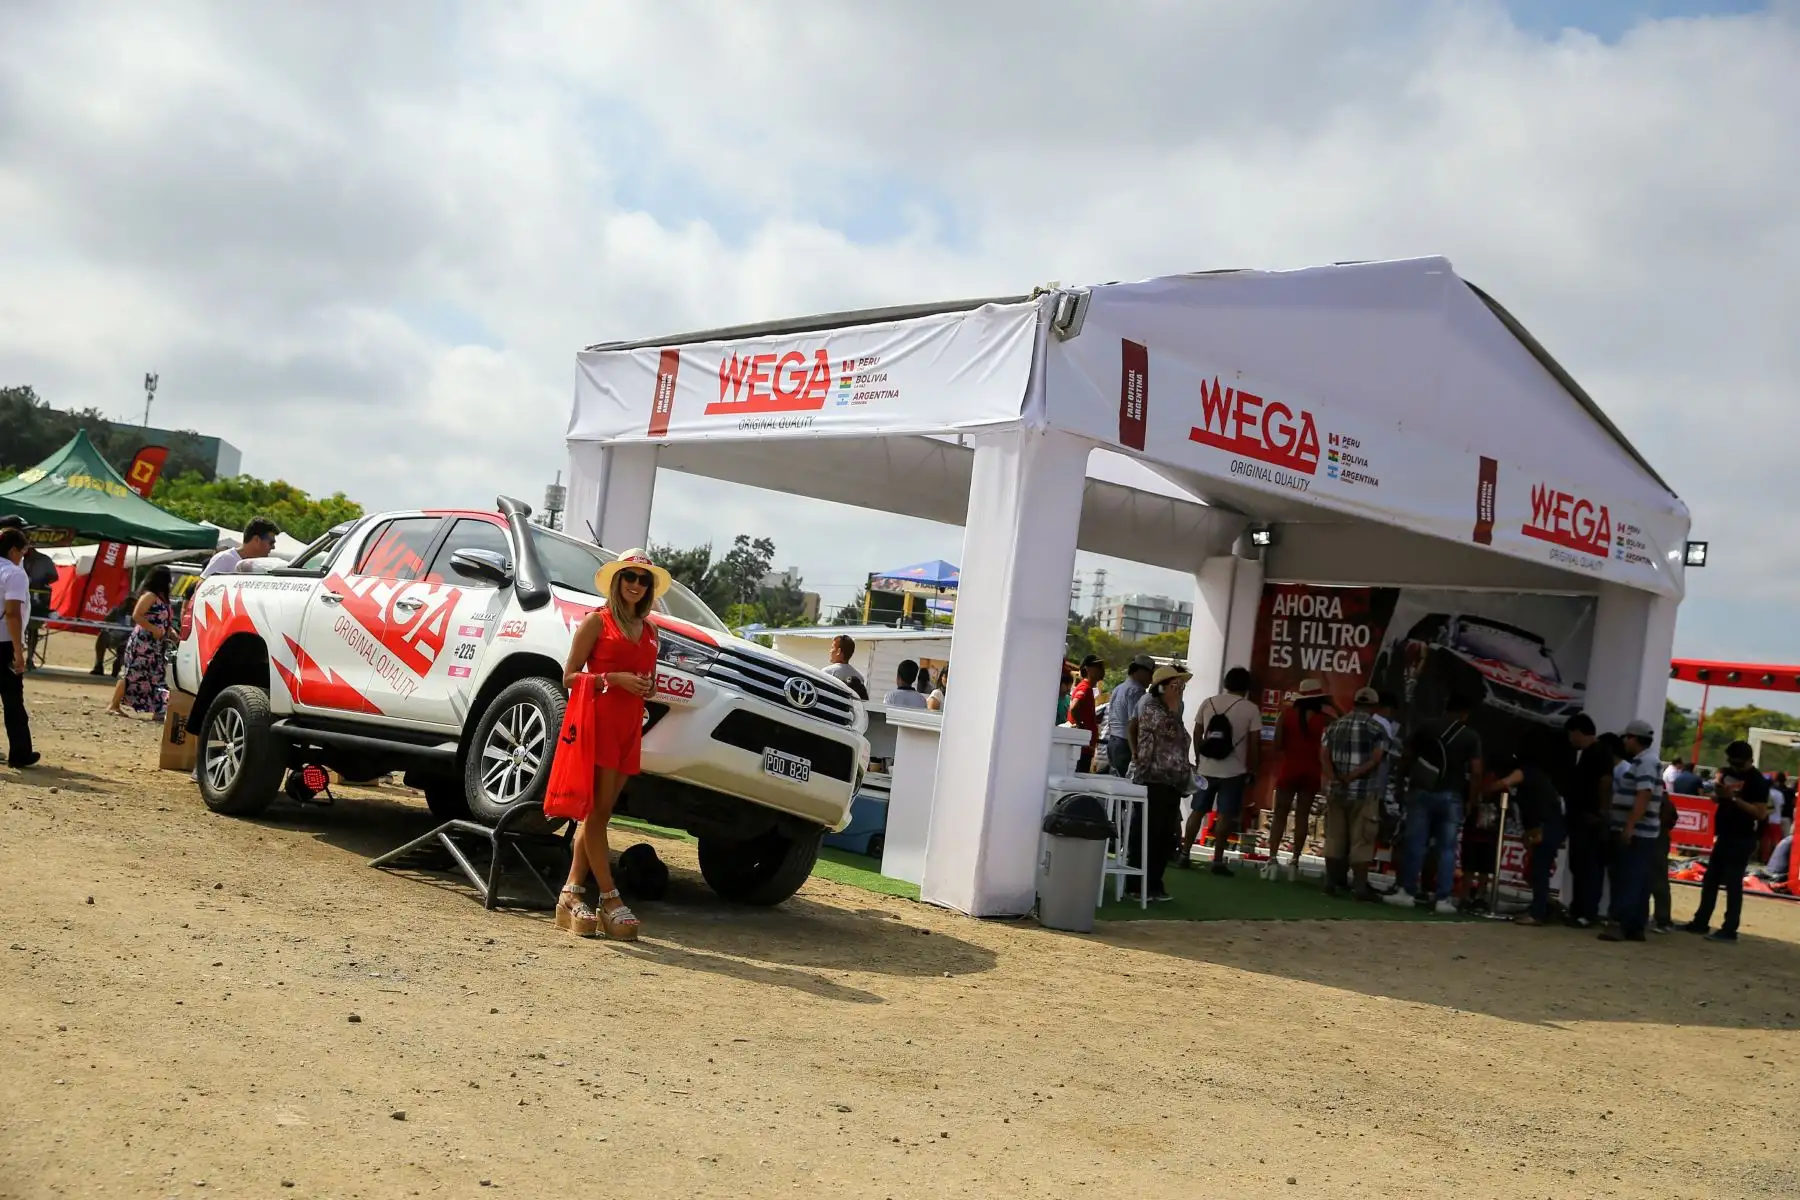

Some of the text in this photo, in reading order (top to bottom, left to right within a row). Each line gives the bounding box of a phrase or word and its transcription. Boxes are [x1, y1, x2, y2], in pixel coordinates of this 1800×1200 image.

[858, 357, 880, 367] PERU
[717, 348, 831, 409] WEGA
[855, 373, 887, 384] BOLIVIA
[852, 390, 899, 401] ARGENTINA
[1134, 374, 1143, 421] ARGENTINA
[739, 415, 816, 431] ORIGINAL QUALITY
[1199, 375, 1321, 462] WEGA
[1342, 436, 1361, 448] PERU
[1342, 452, 1368, 468] BOLIVIA
[1230, 459, 1311, 493] ORIGINAL QUALITY
[1340, 469, 1379, 488] ARGENTINA
[1530, 480, 1612, 549] WEGA
[290, 583, 312, 592] WEGA
[1272, 593, 1343, 619] AHORA
[1271, 619, 1370, 648] EL FILTRO
[334, 615, 419, 701] ORIGINAL QUALITY
[455, 642, 477, 660] #225
[1268, 644, 1362, 675] ES WEGA
[655, 673, 696, 697] EGA
[789, 762, 809, 781] 828
